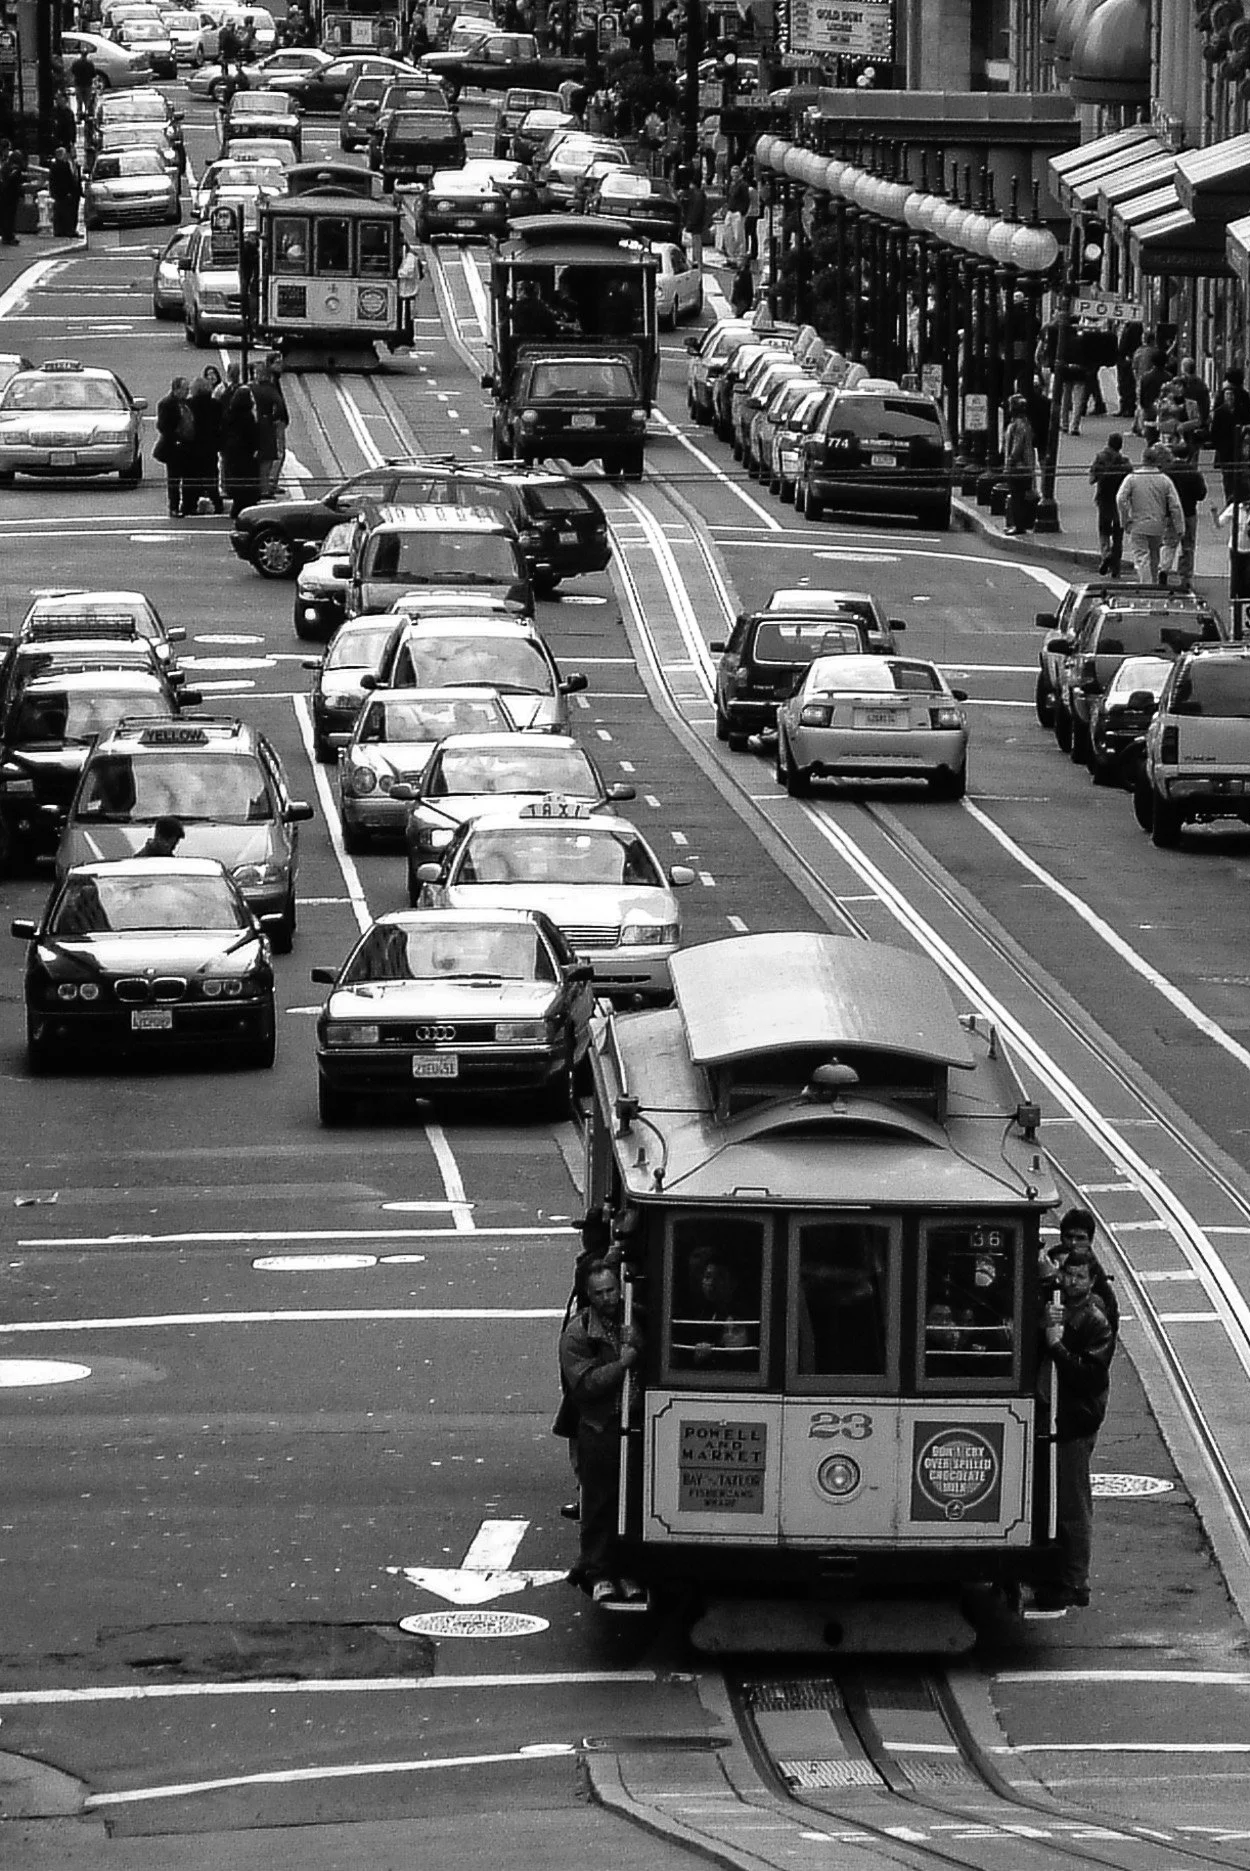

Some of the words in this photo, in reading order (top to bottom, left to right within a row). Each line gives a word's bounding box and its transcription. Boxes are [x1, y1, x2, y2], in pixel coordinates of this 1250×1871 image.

[1080, 301, 1140, 319] POST
[828, 437, 849, 449] 774
[146, 729, 205, 741] YELLOW
[527, 803, 581, 819] TAXI
[808, 1411, 874, 1441] 23
[684, 1427, 761, 1441] POWELL
[705, 1441, 742, 1451] AND
[682, 1449, 761, 1462] MARKET
[929, 1470, 986, 1482] CHOCOLATE
